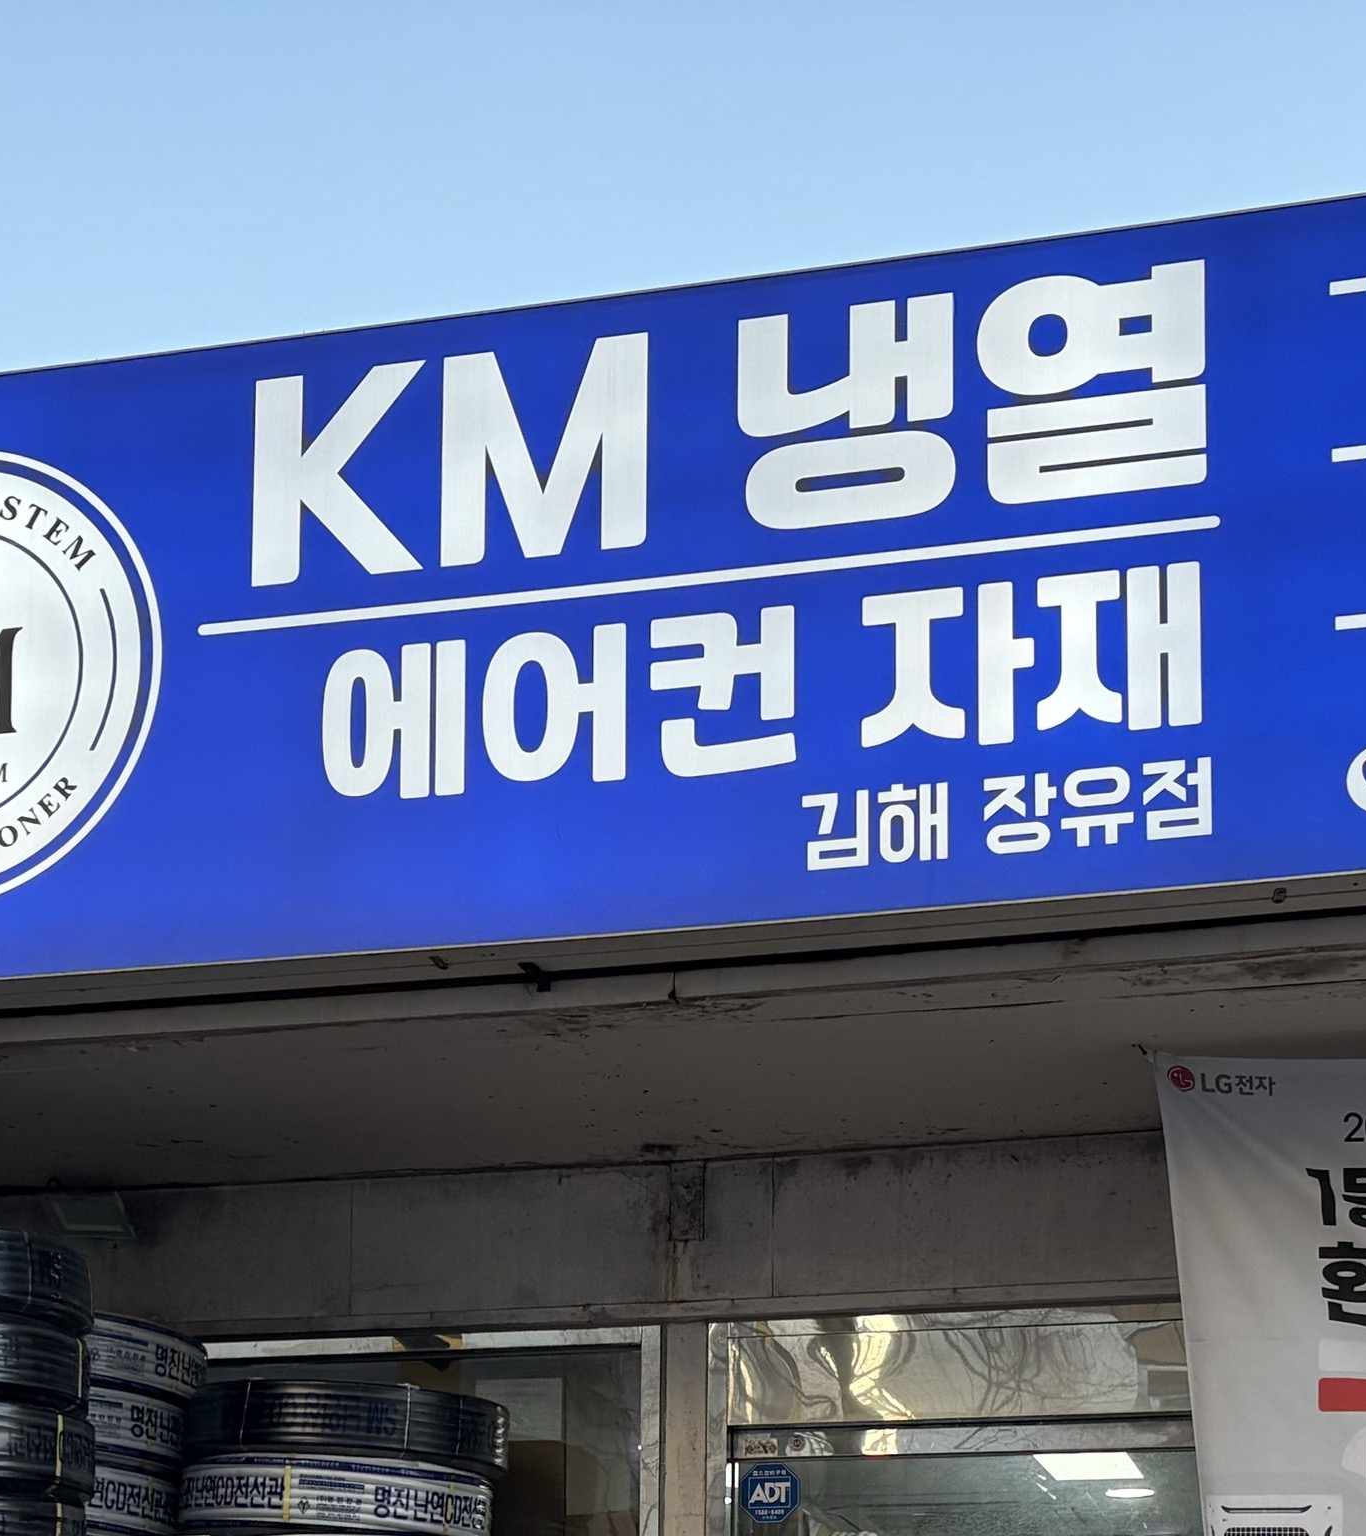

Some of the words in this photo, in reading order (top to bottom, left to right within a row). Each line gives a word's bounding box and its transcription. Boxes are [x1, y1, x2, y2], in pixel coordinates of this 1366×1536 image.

[250, 331, 649, 588] KM
[736, 257, 1207, 531] 냉열
[321, 604, 797, 801] 에어컨
[859, 560, 1203, 750] 자재
[800, 780, 949, 873] 김해
[981, 757, 1213, 857] 장유점
[1201, 1073, 1276, 1097] LG전자
[749, 1482, 791, 1503] ADT
